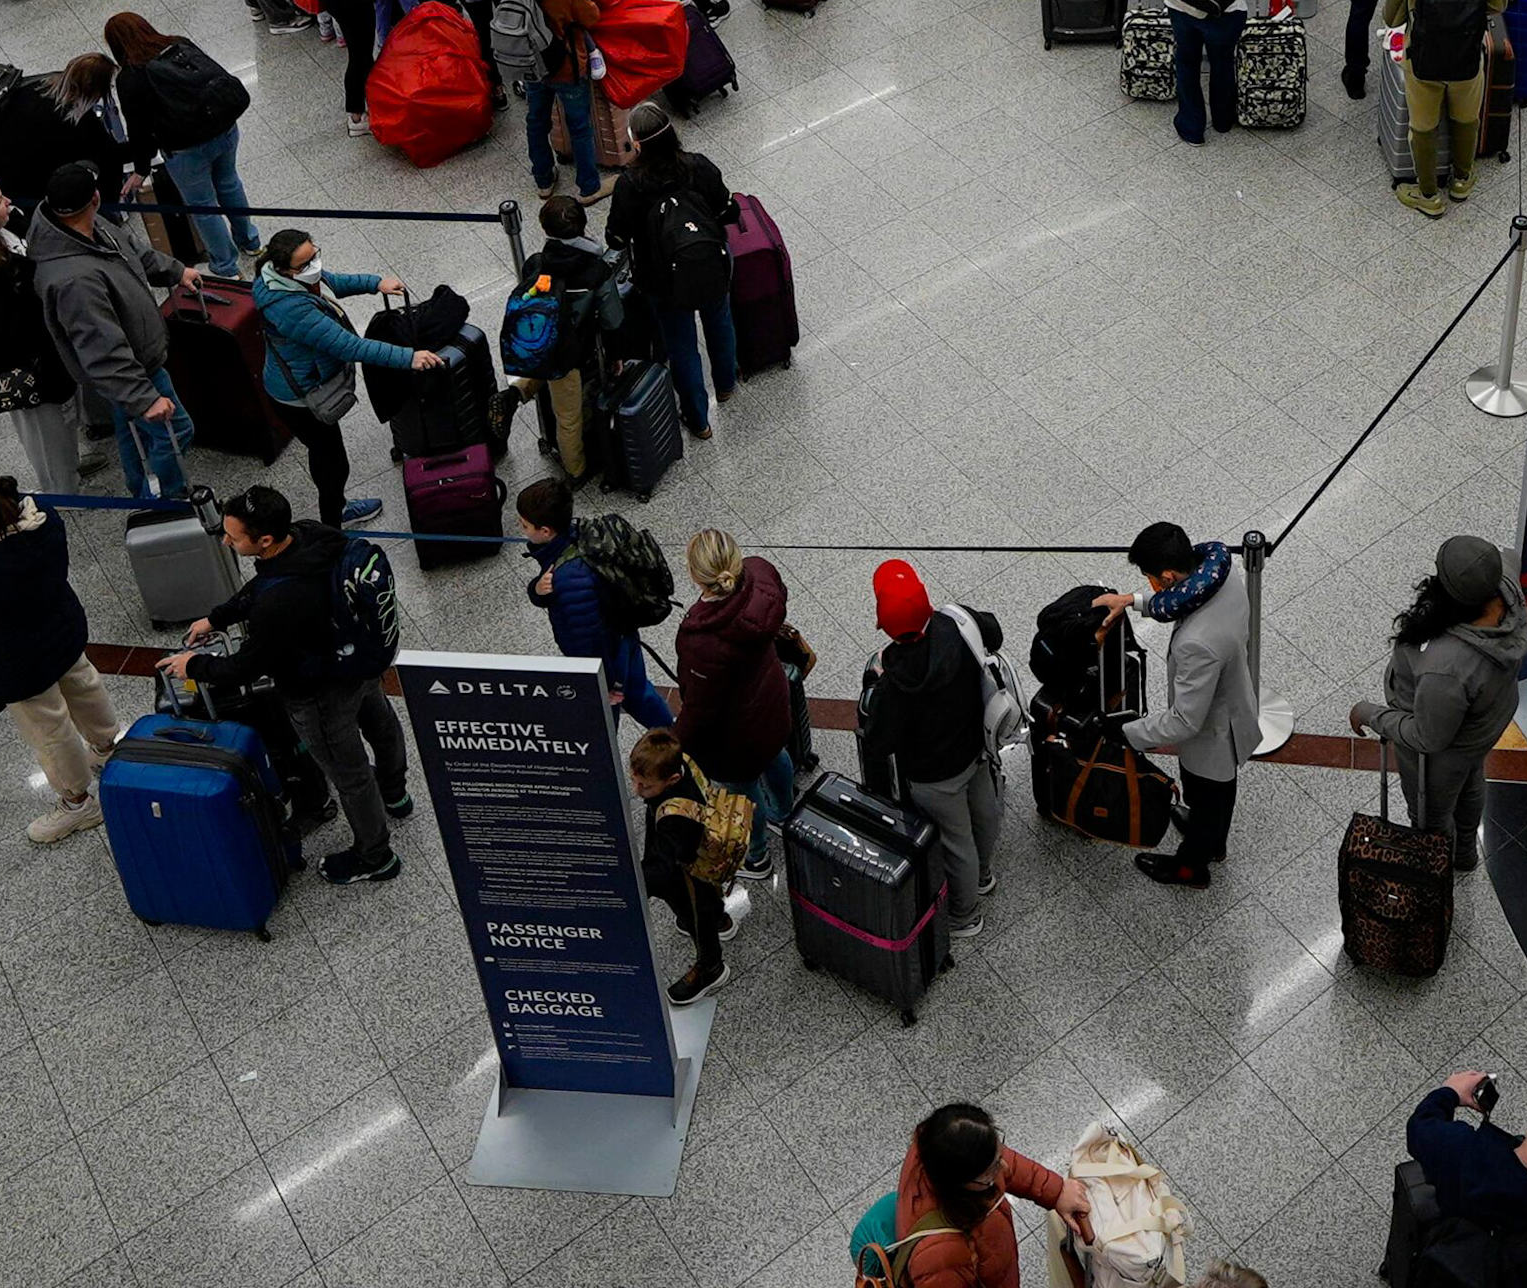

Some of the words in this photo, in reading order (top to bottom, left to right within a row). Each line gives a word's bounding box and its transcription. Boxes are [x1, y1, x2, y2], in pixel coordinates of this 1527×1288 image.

[457, 681, 549, 698] DELTA
[434, 720, 546, 738] EFFECTIVE
[439, 735, 590, 756] IMMEDIATELY
[487, 922, 603, 939] PASSENGER
[490, 935, 567, 950] NOTICE
[504, 990, 595, 1004] CHECKED
[508, 1003, 604, 1018] BAGGAGE
